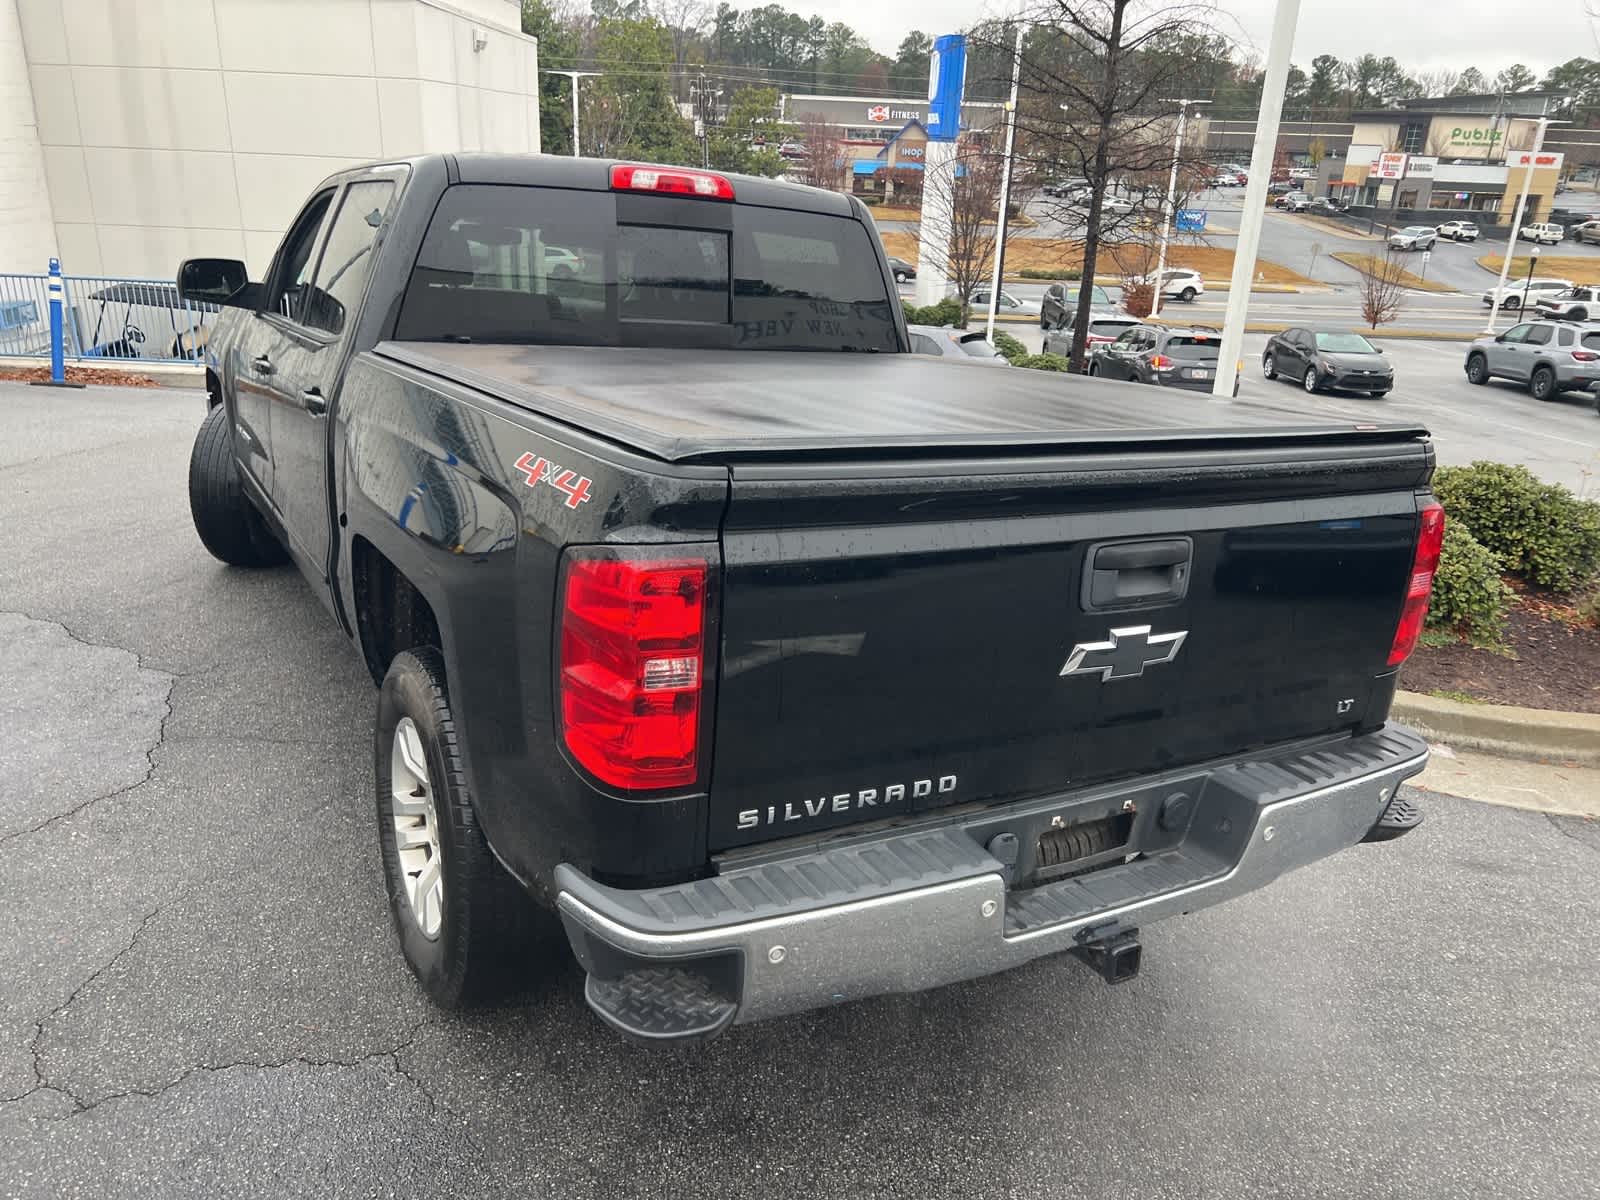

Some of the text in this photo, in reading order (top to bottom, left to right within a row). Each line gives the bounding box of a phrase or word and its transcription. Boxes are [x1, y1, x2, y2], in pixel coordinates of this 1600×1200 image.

[891, 111, 920, 119] FITNESS
[1337, 698, 1354, 714] LT
[737, 775, 957, 829] SILVERADO
